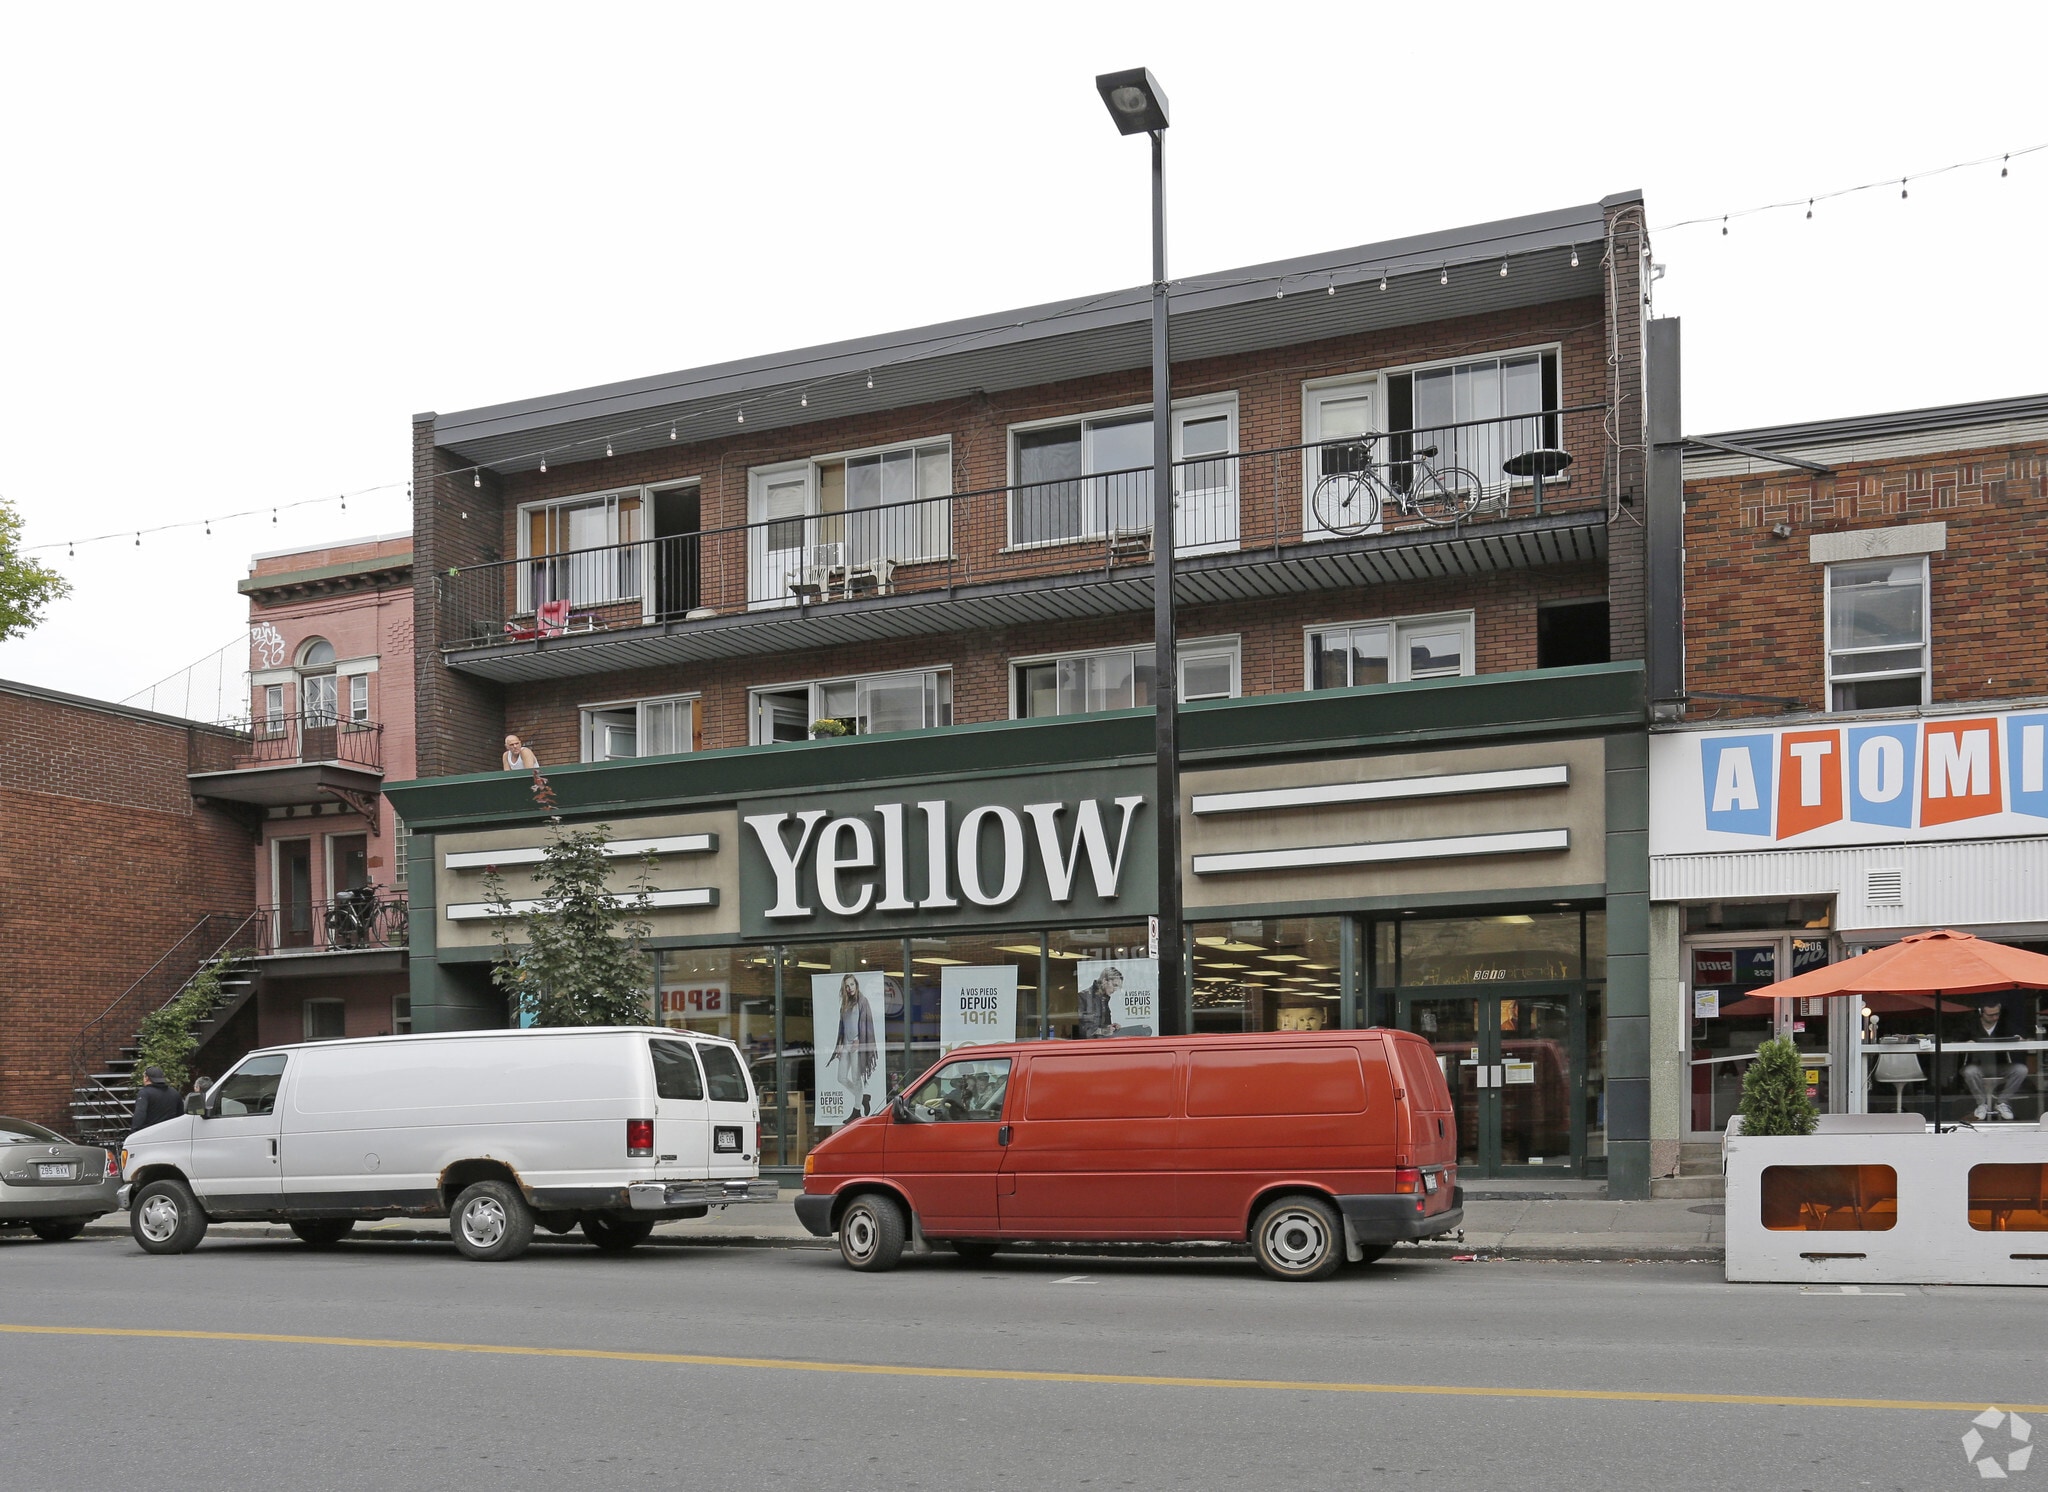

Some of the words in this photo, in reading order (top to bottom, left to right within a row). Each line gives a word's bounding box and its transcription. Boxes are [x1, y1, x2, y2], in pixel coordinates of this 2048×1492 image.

[1473, 969, 1506, 981] 3610
[966, 987, 979, 996] VOS
[979, 987, 998, 996] PIEDS
[960, 996, 998, 1010] DEPUIS
[1124, 996, 1151, 1006] DEPUIS
[1125, 1005, 1151, 1016] 1916
[960, 1010, 998, 1025] 1916
[820, 1096, 844, 1105] DEPUIS
[821, 1105, 844, 1115] 1916
